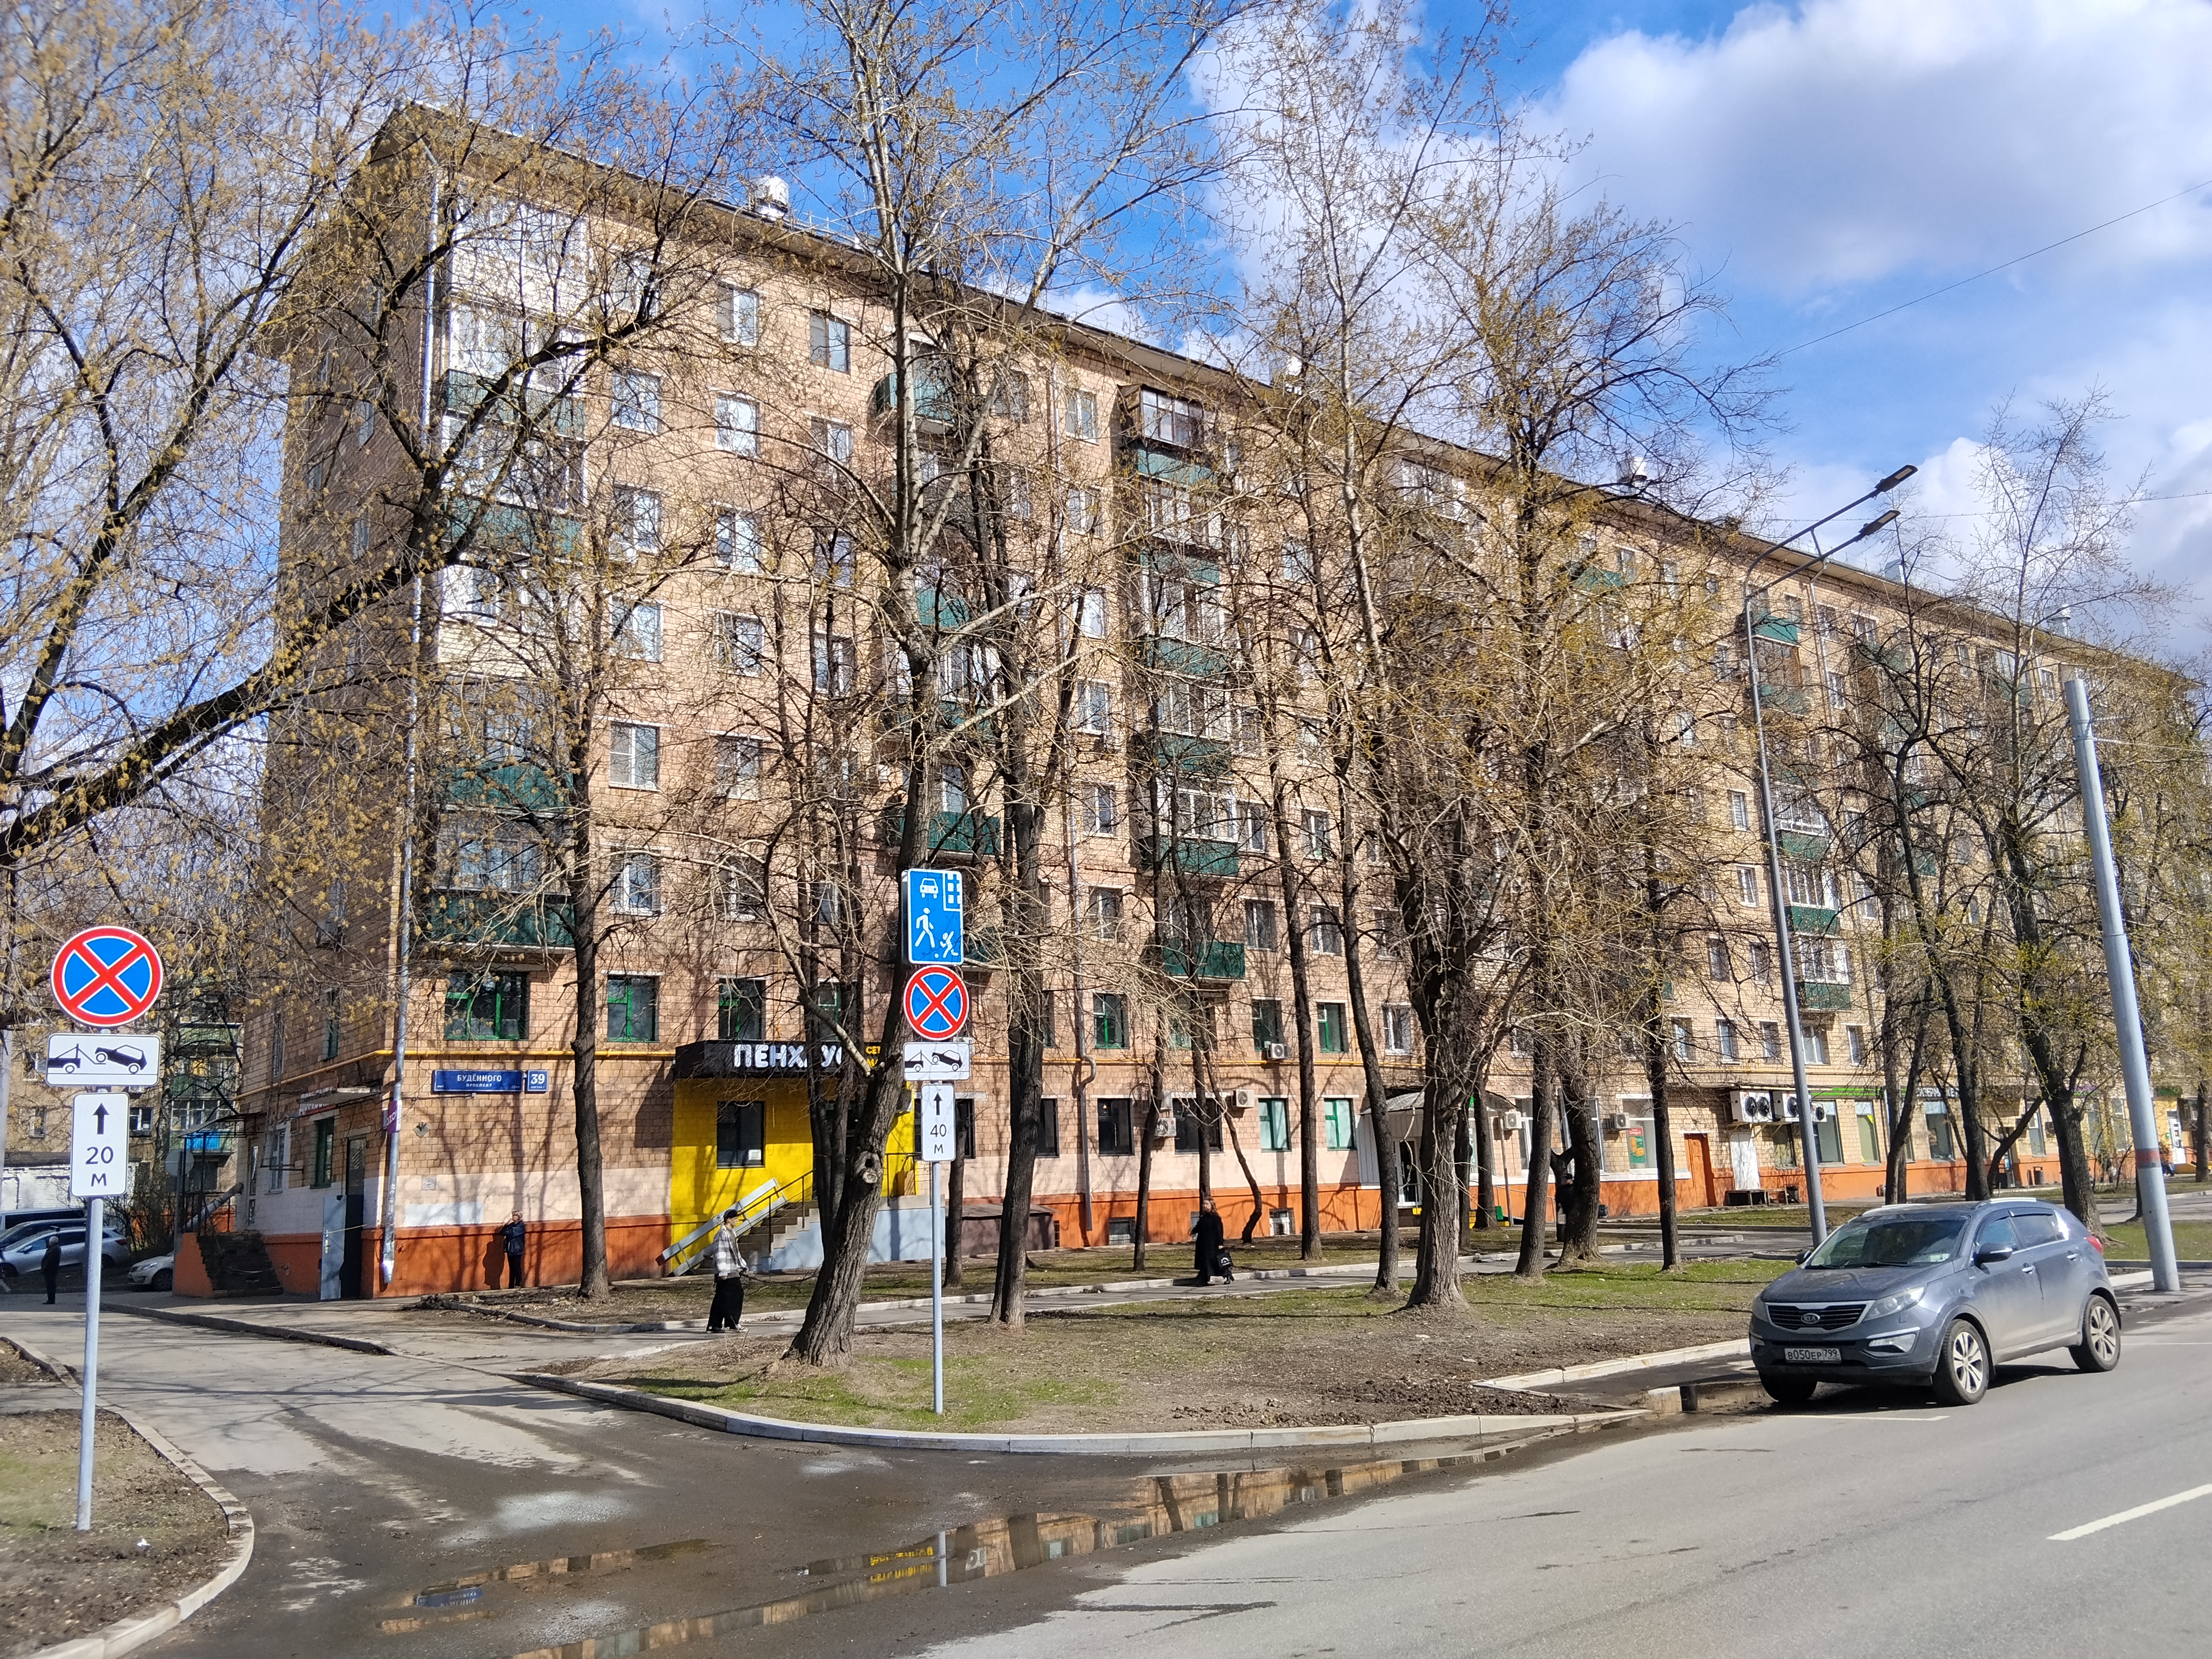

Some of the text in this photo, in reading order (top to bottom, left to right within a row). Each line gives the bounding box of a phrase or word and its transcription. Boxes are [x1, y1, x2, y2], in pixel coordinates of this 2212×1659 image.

[734, 1044, 841, 1068] ПЕНХУ
[457, 1074, 502, 1082] БУДЁННОГО
[531, 1074, 545, 1084] 39
[930, 1124, 947, 1137] 40
[85, 1146, 113, 1164] 20
[934, 1144, 944, 1154] М
[91, 1173, 107, 1186] М
